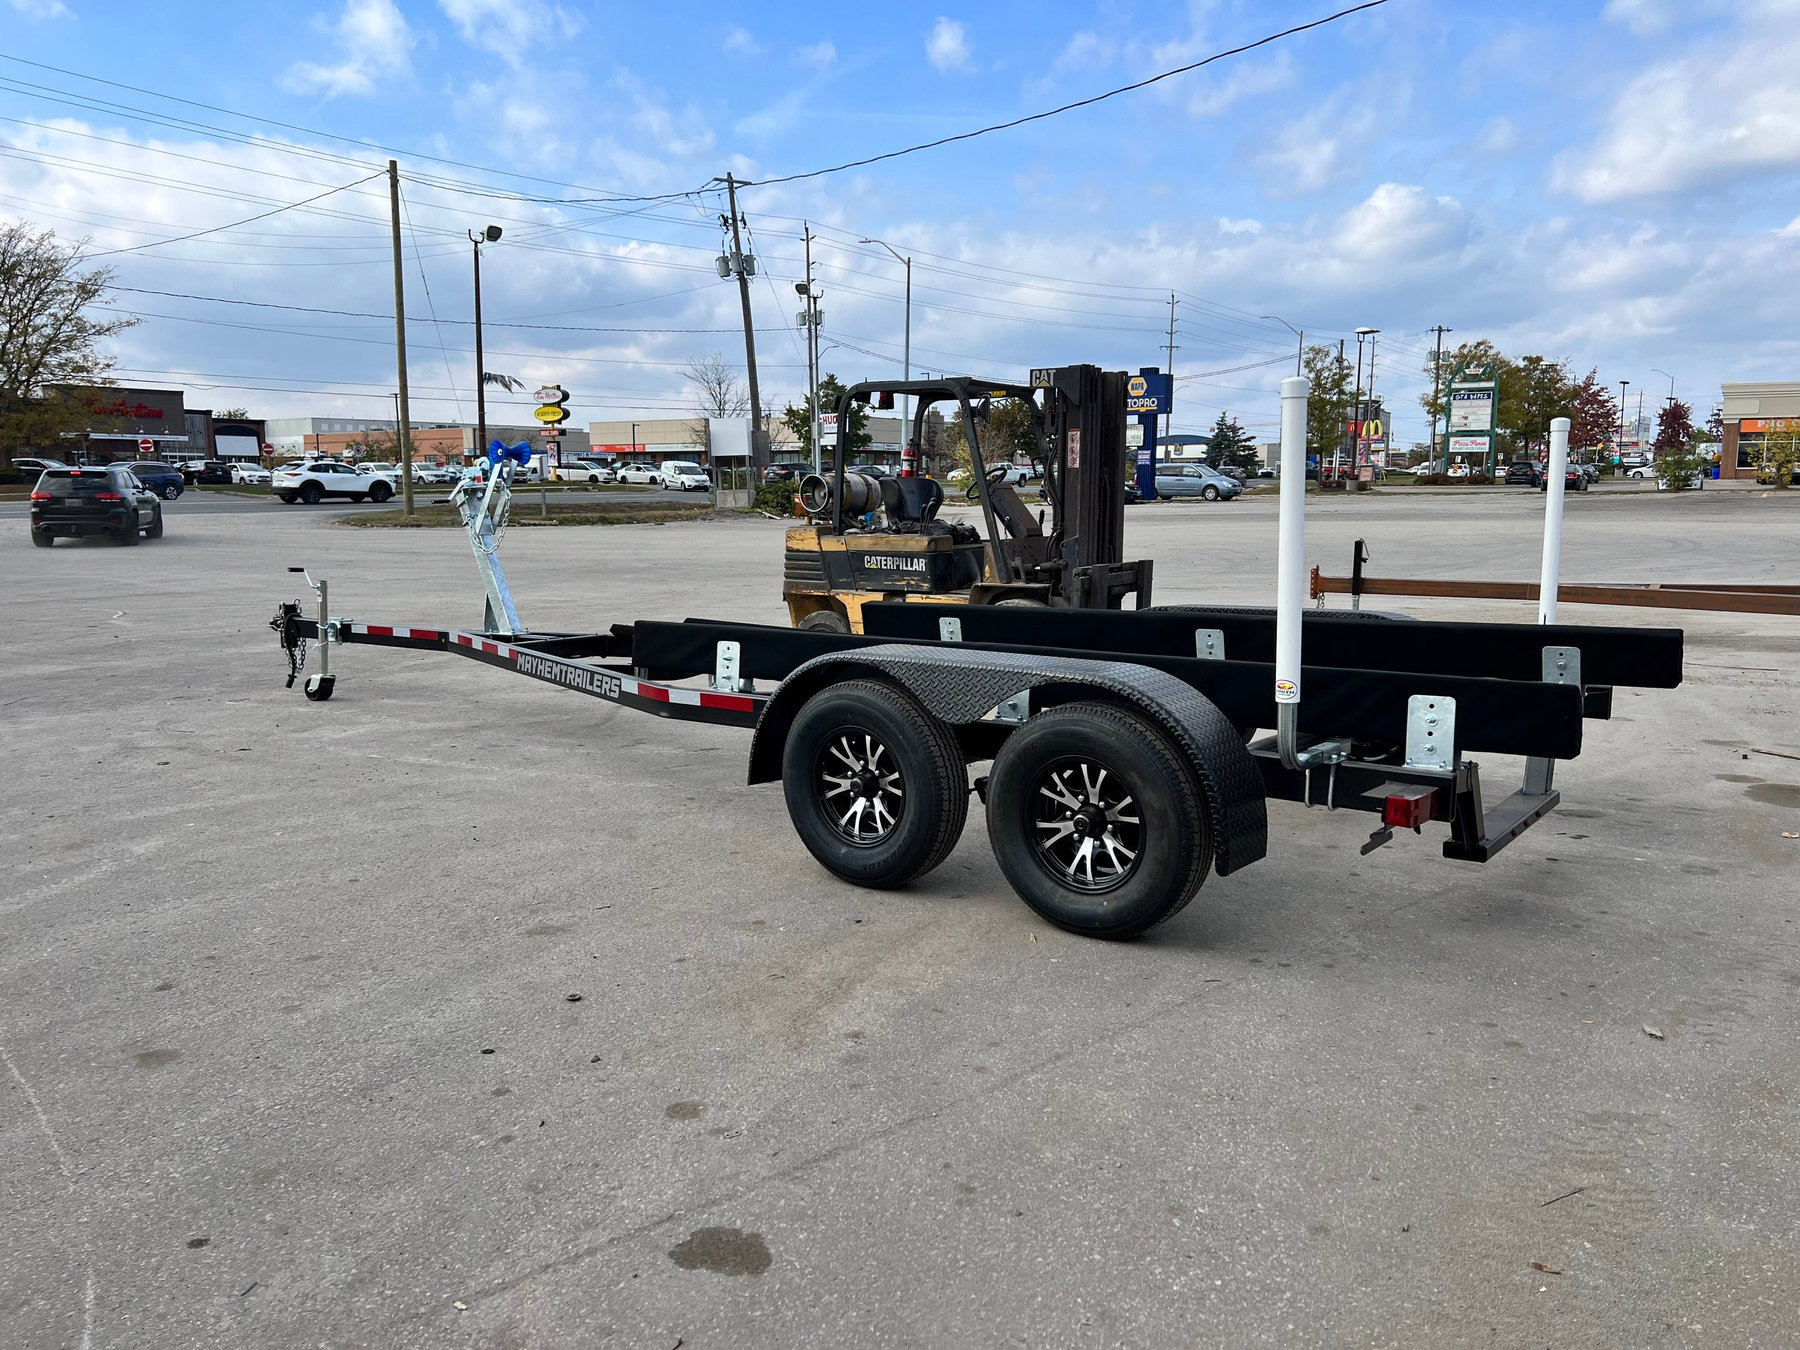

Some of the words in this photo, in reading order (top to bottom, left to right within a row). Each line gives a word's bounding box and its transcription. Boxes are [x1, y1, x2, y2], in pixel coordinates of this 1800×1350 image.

[1032, 370, 1056, 387] CAT
[1130, 382, 1144, 392] NAPA
[864, 556, 926, 572] CATERPILLAR
[517, 654, 620, 698] MAYHEMTRAILERS
